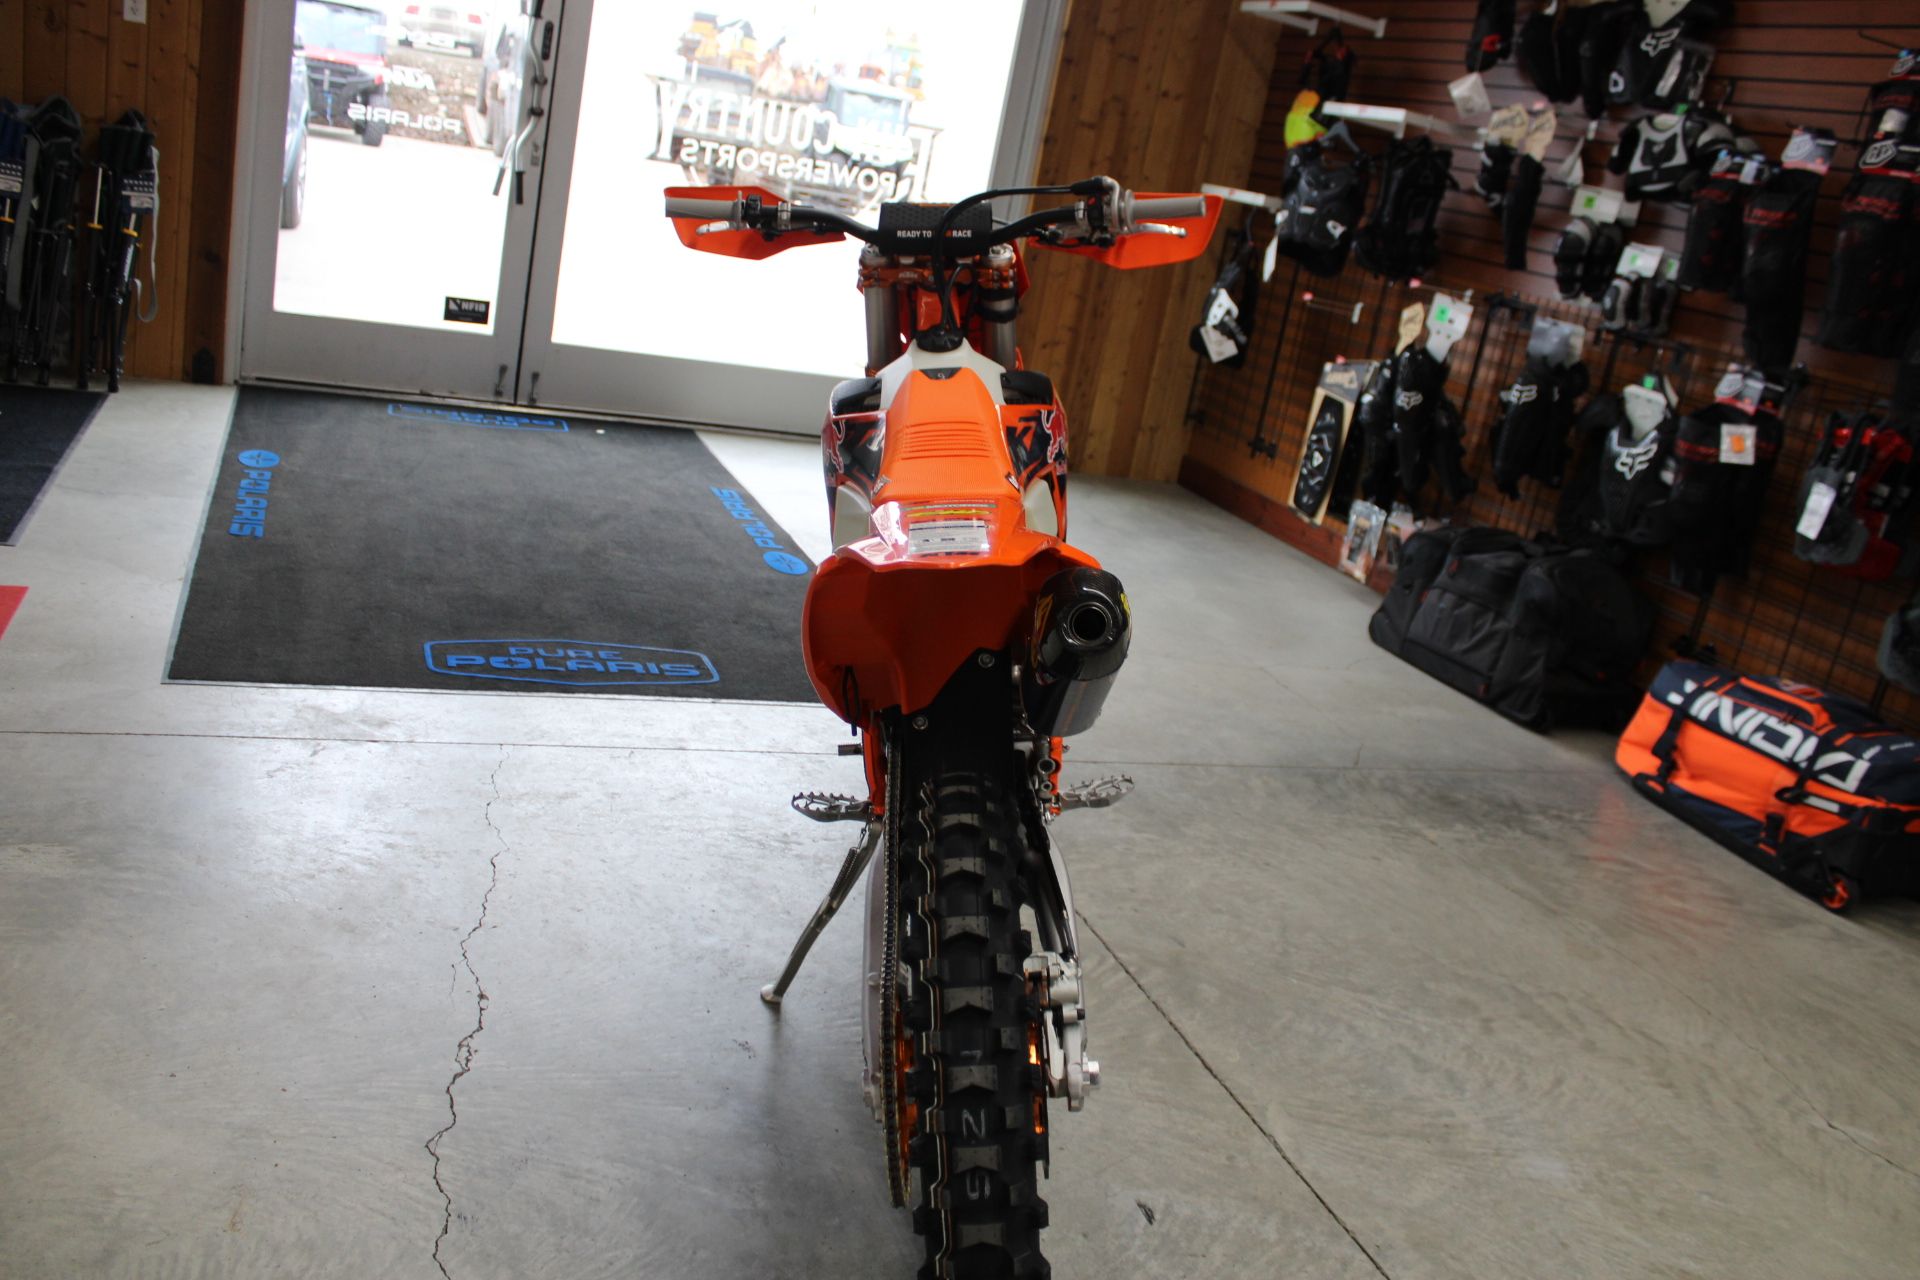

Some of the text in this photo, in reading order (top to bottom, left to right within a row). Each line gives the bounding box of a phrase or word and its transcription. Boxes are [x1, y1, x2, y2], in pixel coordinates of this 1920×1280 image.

[897, 230, 972, 238] READY TO RACE
[508, 646, 624, 660] PURE
[446, 654, 701, 677] POLARIS
